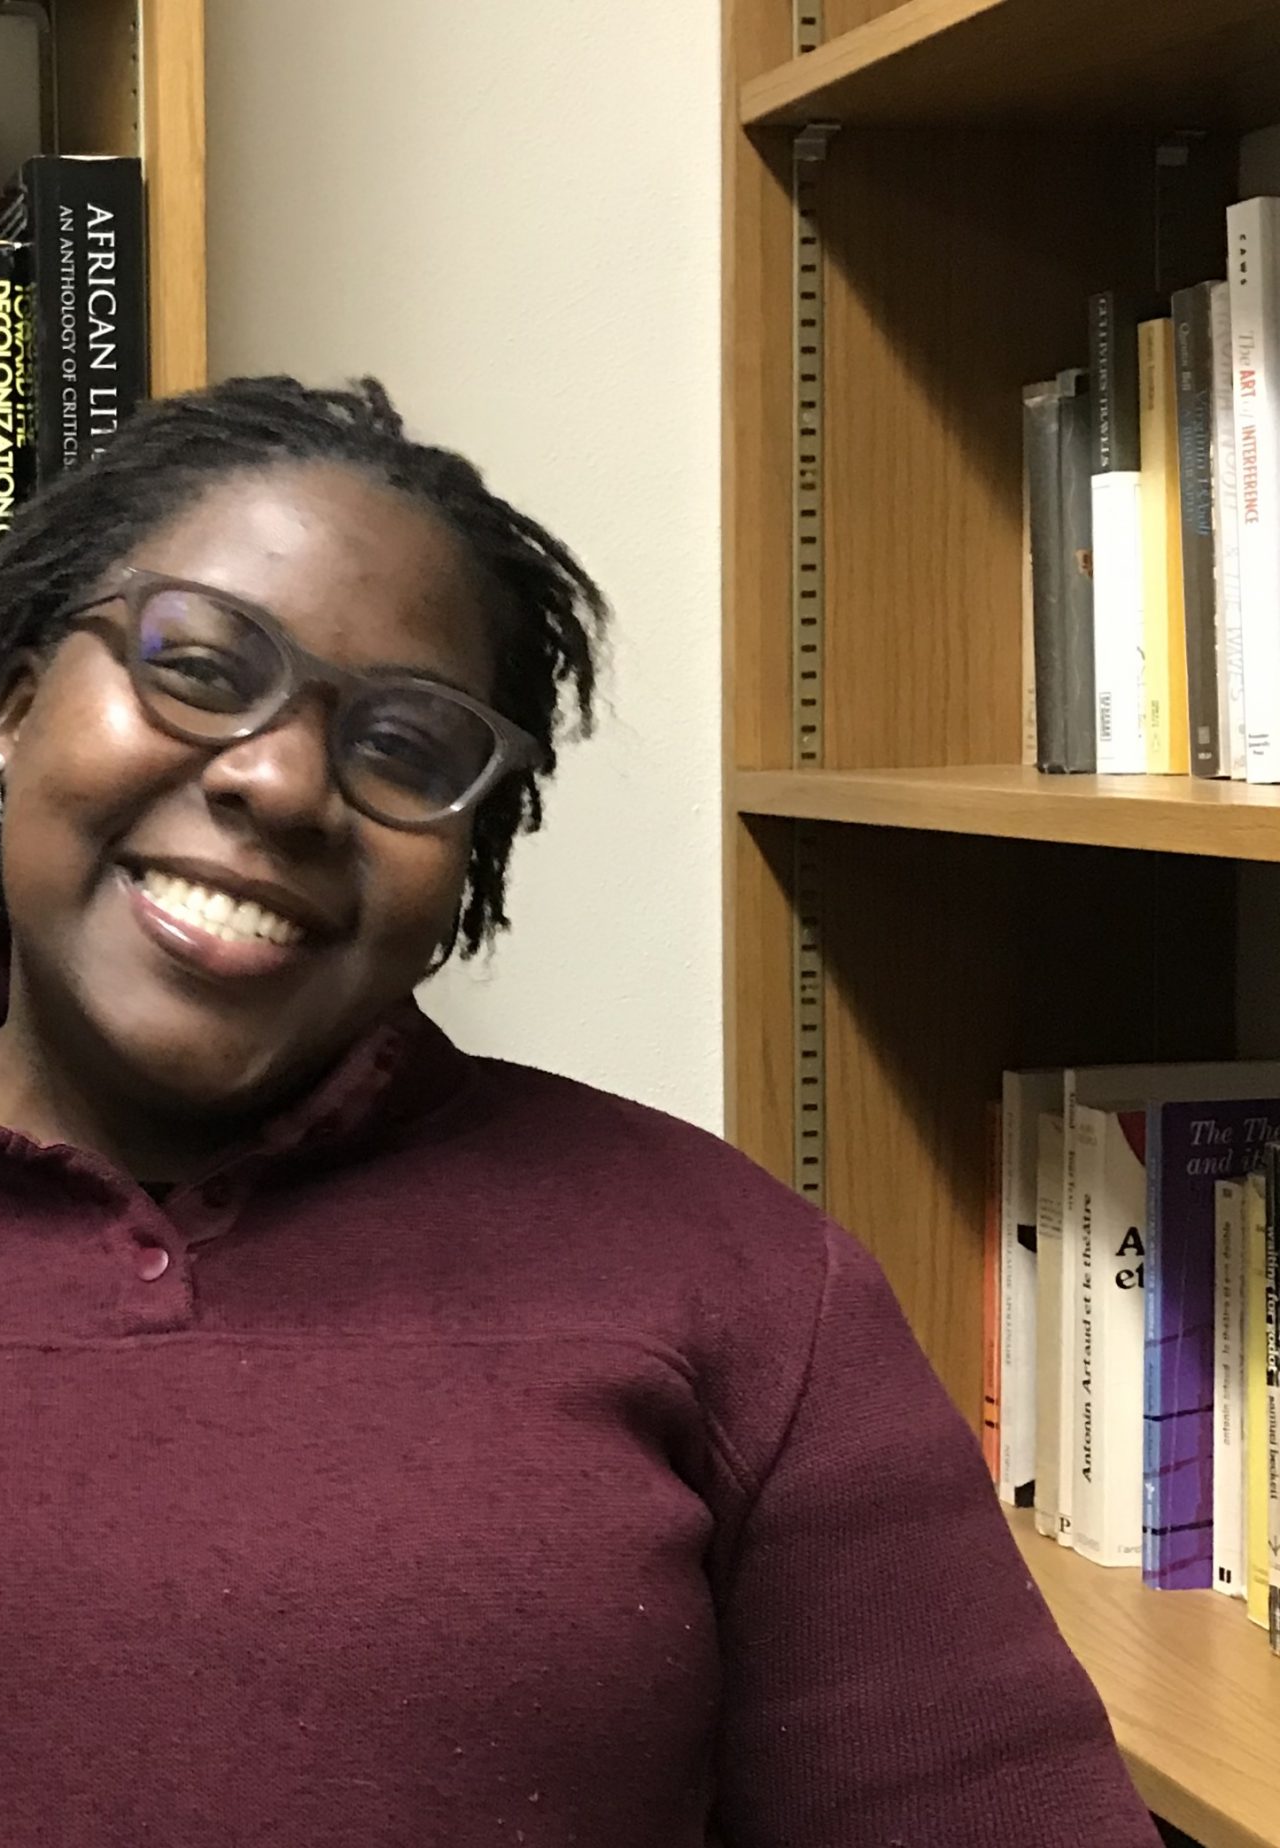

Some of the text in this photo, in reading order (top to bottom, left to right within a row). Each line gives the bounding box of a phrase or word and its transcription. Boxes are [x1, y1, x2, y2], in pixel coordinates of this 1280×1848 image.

[58, 205, 77, 382] AN ANTHOLOGY OF
[87, 203, 117, 371] AFRICAN
[1238, 330, 1259, 525] The ART INTERFERENCE
[1187, 1149, 1232, 1175] and
[1082, 1272, 1092, 1289] le
[1266, 1291, 1278, 1318] for
[1081, 1317, 1092, 1394] Artaud
[1082, 1402, 1092, 1483] Antonin
